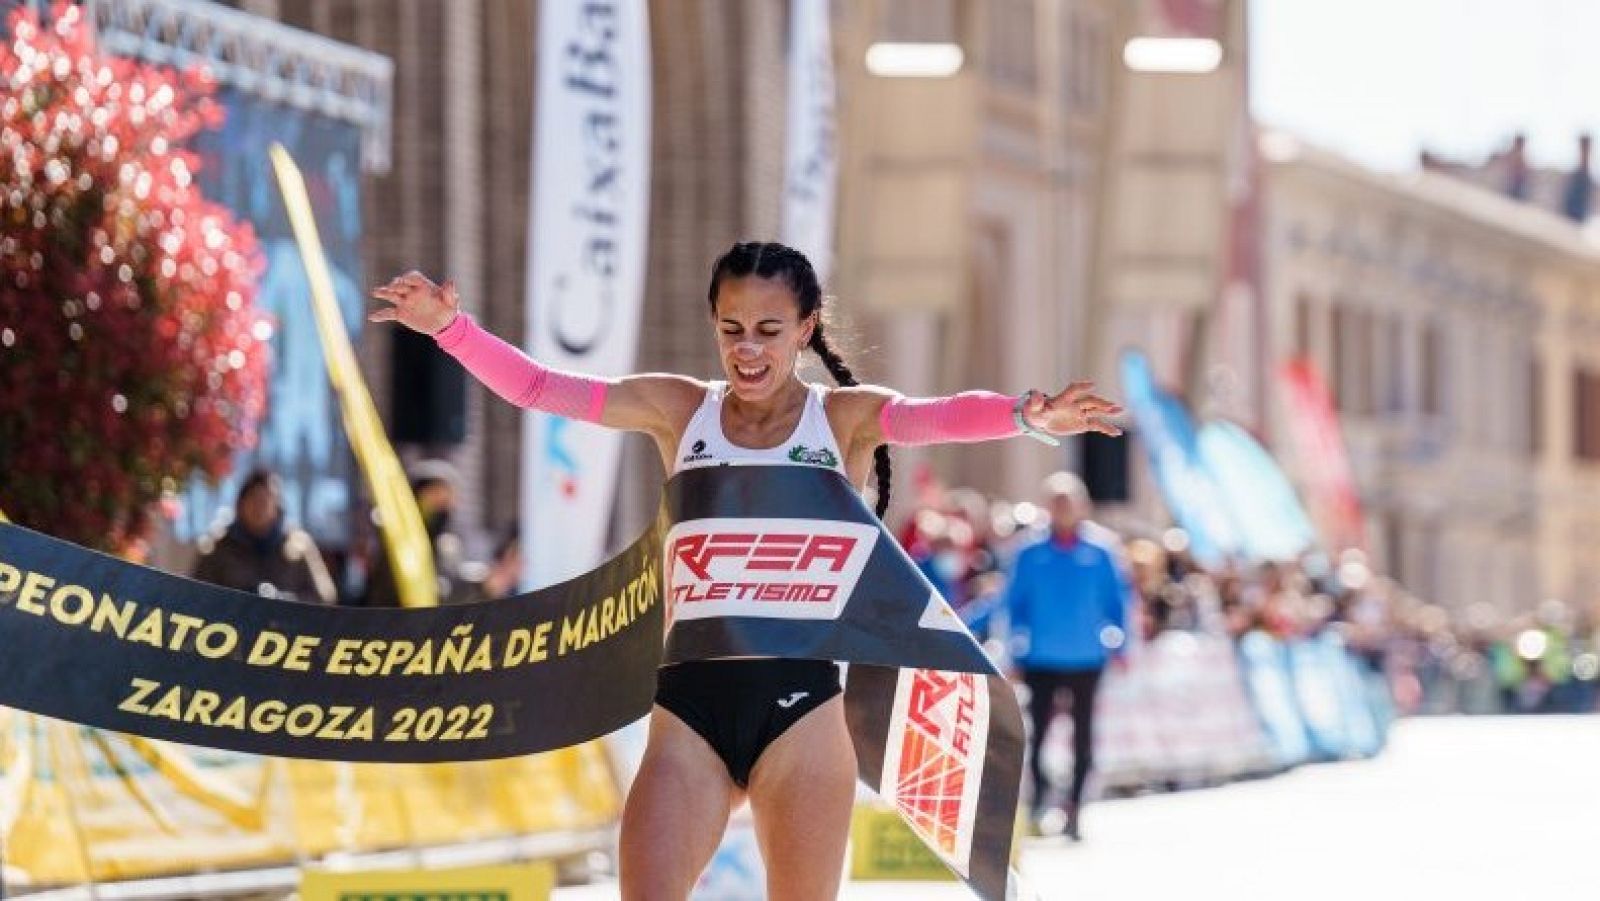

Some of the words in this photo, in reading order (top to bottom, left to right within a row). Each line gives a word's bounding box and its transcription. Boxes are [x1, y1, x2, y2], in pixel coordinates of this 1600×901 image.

[674, 534, 858, 581] RFEA
[247, 631, 321, 671] DE
[326, 623, 493, 676] ESPAÑA
[503, 621, 553, 669] DE
[557, 554, 658, 657] MARATÓN
[117, 677, 375, 741] ZARAGOZA
[384, 704, 494, 741] 2022
